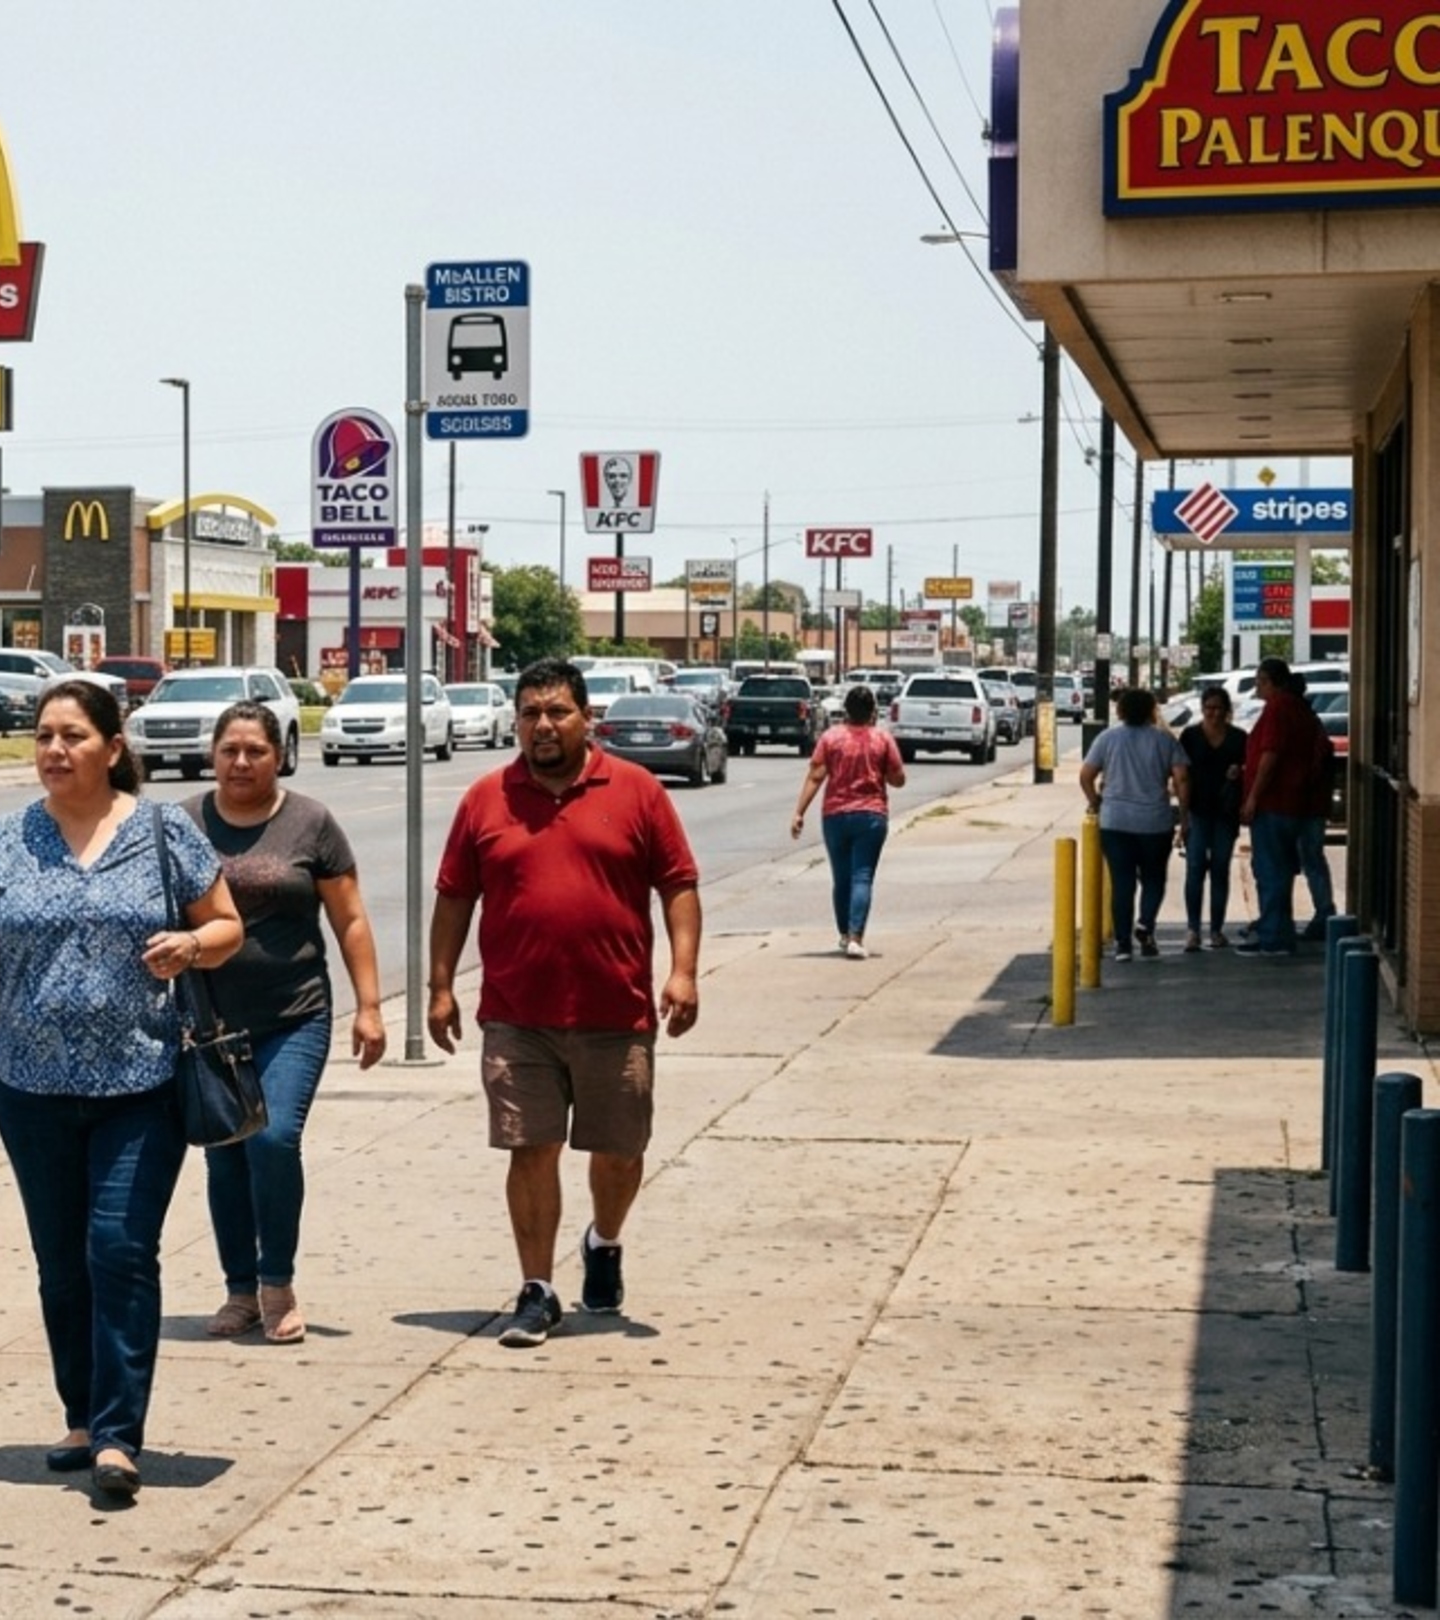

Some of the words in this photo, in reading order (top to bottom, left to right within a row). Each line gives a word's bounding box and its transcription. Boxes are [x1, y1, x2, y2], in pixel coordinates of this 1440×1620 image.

[1200, 14, 1440, 93] TACO
[317, 483, 389, 501] TACO
[321, 505, 389, 522] BELL
[1252, 496, 1348, 525] stripes
[811, 532, 869, 553] KFC
